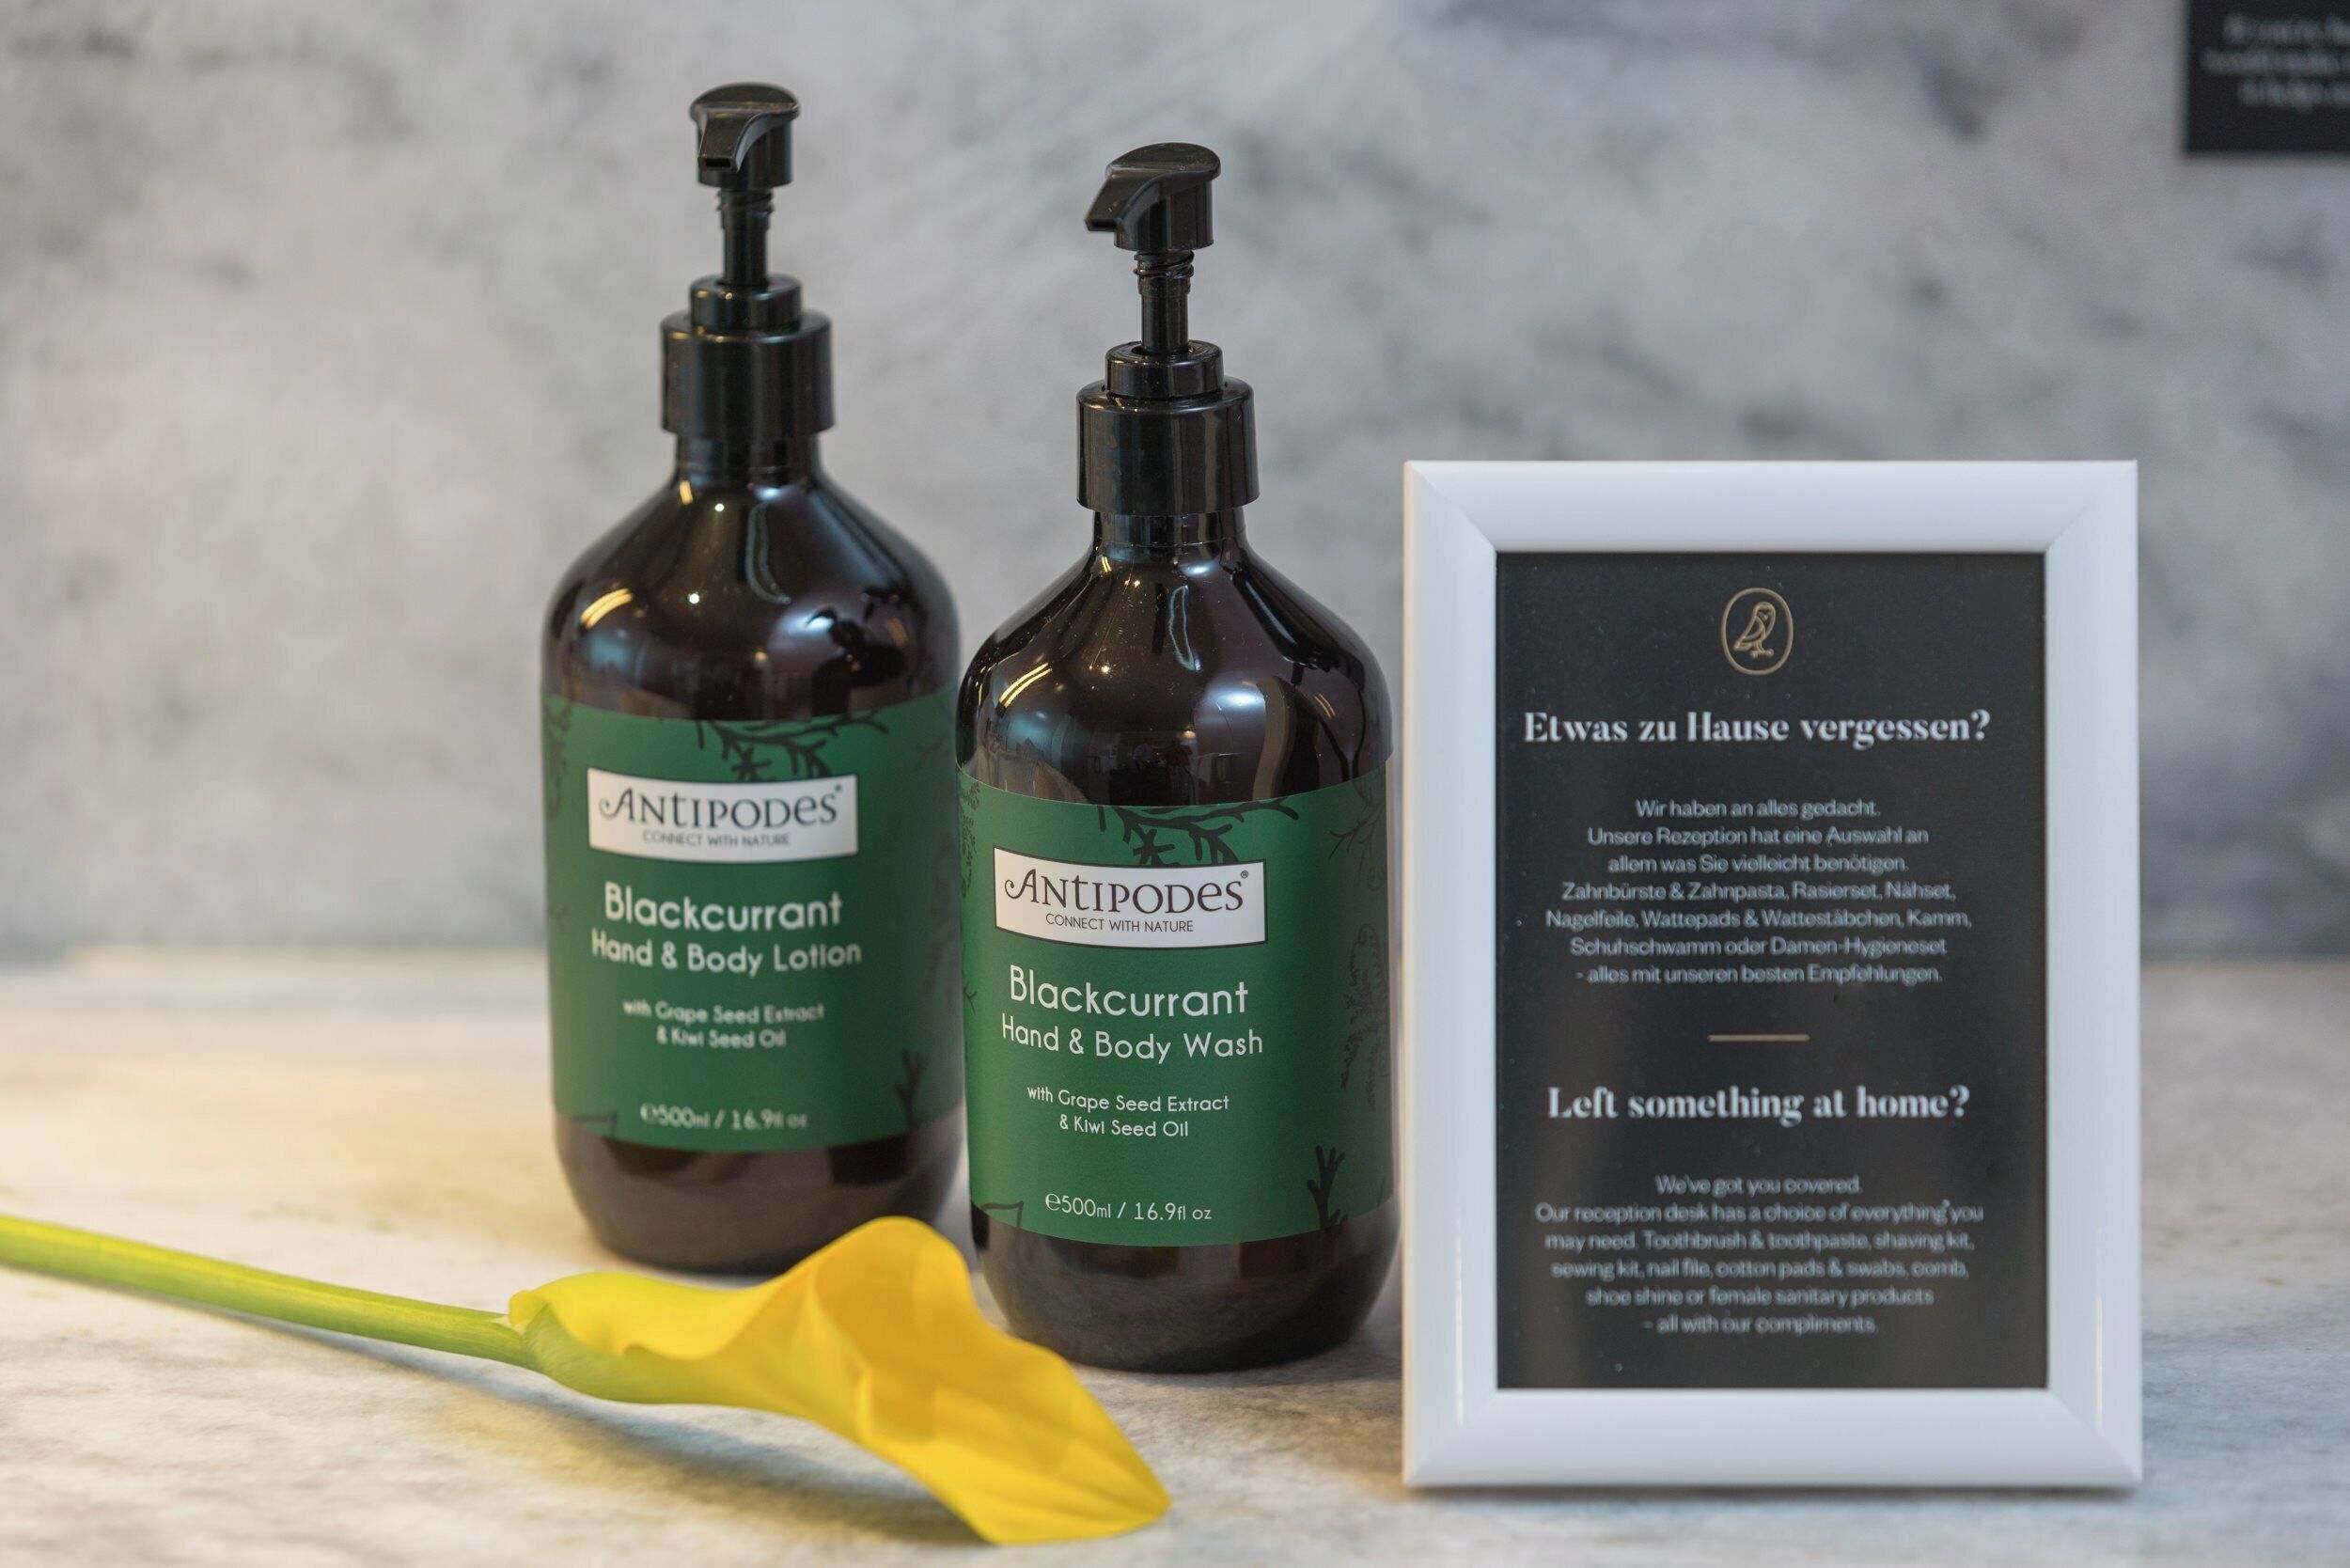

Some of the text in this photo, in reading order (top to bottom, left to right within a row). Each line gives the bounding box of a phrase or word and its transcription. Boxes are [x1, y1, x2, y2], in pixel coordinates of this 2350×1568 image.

[1524, 709, 1990, 750] Etwas zu Hause vergessen?
[1636, 799, 1880, 821] Wir haben an alles gedacht.
[642, 829, 790, 846] CONNECT WITH NATURE
[1588, 826, 1929, 848] Unsere Rezeption hat eine Auswahl an
[1607, 855, 1657, 872] allem
[1660, 859, 1697, 872] was
[1699, 855, 1728, 872] Sie
[1731, 855, 1811, 873] vielleicht
[1561, 881, 1956, 902] Zahnbürste & Zahnpasta, Rasierset, Nähset,
[604, 881, 842, 931] Blackcurrant
[1045, 912, 1194, 933] CONNECT WITH NATURE
[1545, 910, 1638, 932] Nagelfeile,
[1641, 910, 1741, 931] Wattepads
[1743, 910, 1759, 928] &
[1906, 909, 1972, 928] Kamm,
[592, 929, 862, 977] Hand & Body Lotion
[1570, 936, 1947, 959] Schuhschwamm oder Damen-Hygieneset
[1587, 965, 1629, 983] alles
[1632, 964, 1660, 983] mit
[1664, 969, 1738, 983] unseren
[1741, 964, 1805, 982] besten
[1010, 964, 1248, 1017] Blackcurrant
[622, 999, 824, 1027] with Grape Seed Extract
[656, 1025, 786, 1048] & Kiwi Seed Oil
[1002, 1013, 1262, 1064] Hand & Body Wash
[1027, 1086, 1230, 1113] with Grape Seed Extract
[1547, 1085, 1970, 1127] Left something at home?
[1059, 1114, 1188, 1137] & Kiwi Seed Oil
[1655, 1174, 1711, 1195] We've
[1712, 1178, 1744, 1199] got
[1747, 1178, 1780, 1198] you
[1117, 1201, 1125, 1219] /
[1134, 1201, 1186, 1222] 16.9fl
[1192, 1206, 1212, 1221] oz
[1535, 1201, 1571, 1222] Our
[1574, 1203, 1662, 1225] reception
[1664, 1202, 1710, 1222] desk
[1712, 1202, 1746, 1221] has
[1749, 1206, 1761, 1221] a
[1763, 1202, 1826, 1222] choice
[1828, 1201, 1850, 1222] of
[1950, 1206, 1983, 1225] you
[1544, 1233, 1585, 1254] may
[1641, 1230, 1747, 1249] Toothbrush
[1749, 1231, 1764, 1249] &
[1873, 1231, 1945, 1253] shaving
[1551, 1260, 1615, 1281] sewing
[1647, 1259, 1679, 1278] nail
[1716, 1261, 1776, 1278] cotton
[1778, 1259, 1825, 1281] pads
[1828, 1257, 1843, 1278] &
[1585, 1285, 1935, 1309] shoe shine or female sanitary products
[1656, 1314, 1678, 1334] all
[1681, 1313, 1718, 1334] with
[1720, 1317, 1752, 1334] our
